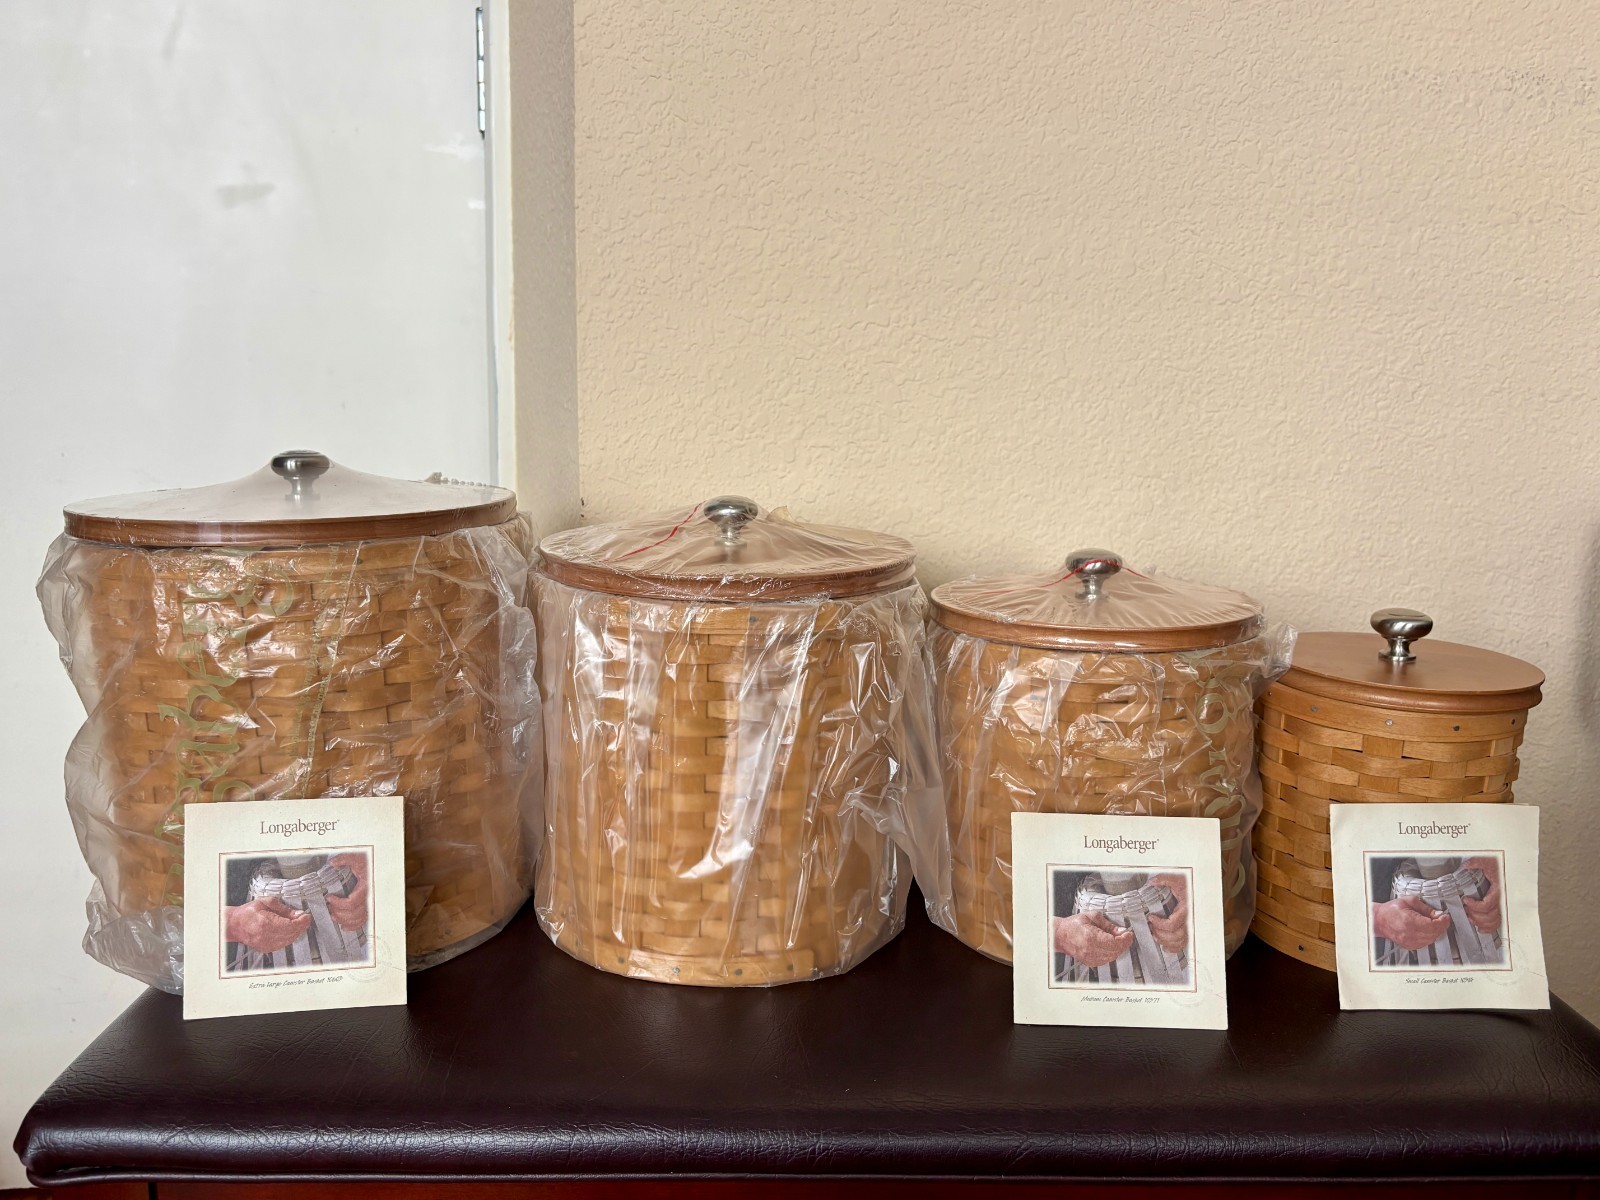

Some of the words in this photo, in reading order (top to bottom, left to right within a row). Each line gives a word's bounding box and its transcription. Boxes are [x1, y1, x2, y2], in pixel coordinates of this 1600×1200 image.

[260, 818, 338, 837] Longaberger
[1397, 820, 1469, 839] Longaberger
[1083, 835, 1158, 854] Longaberger
